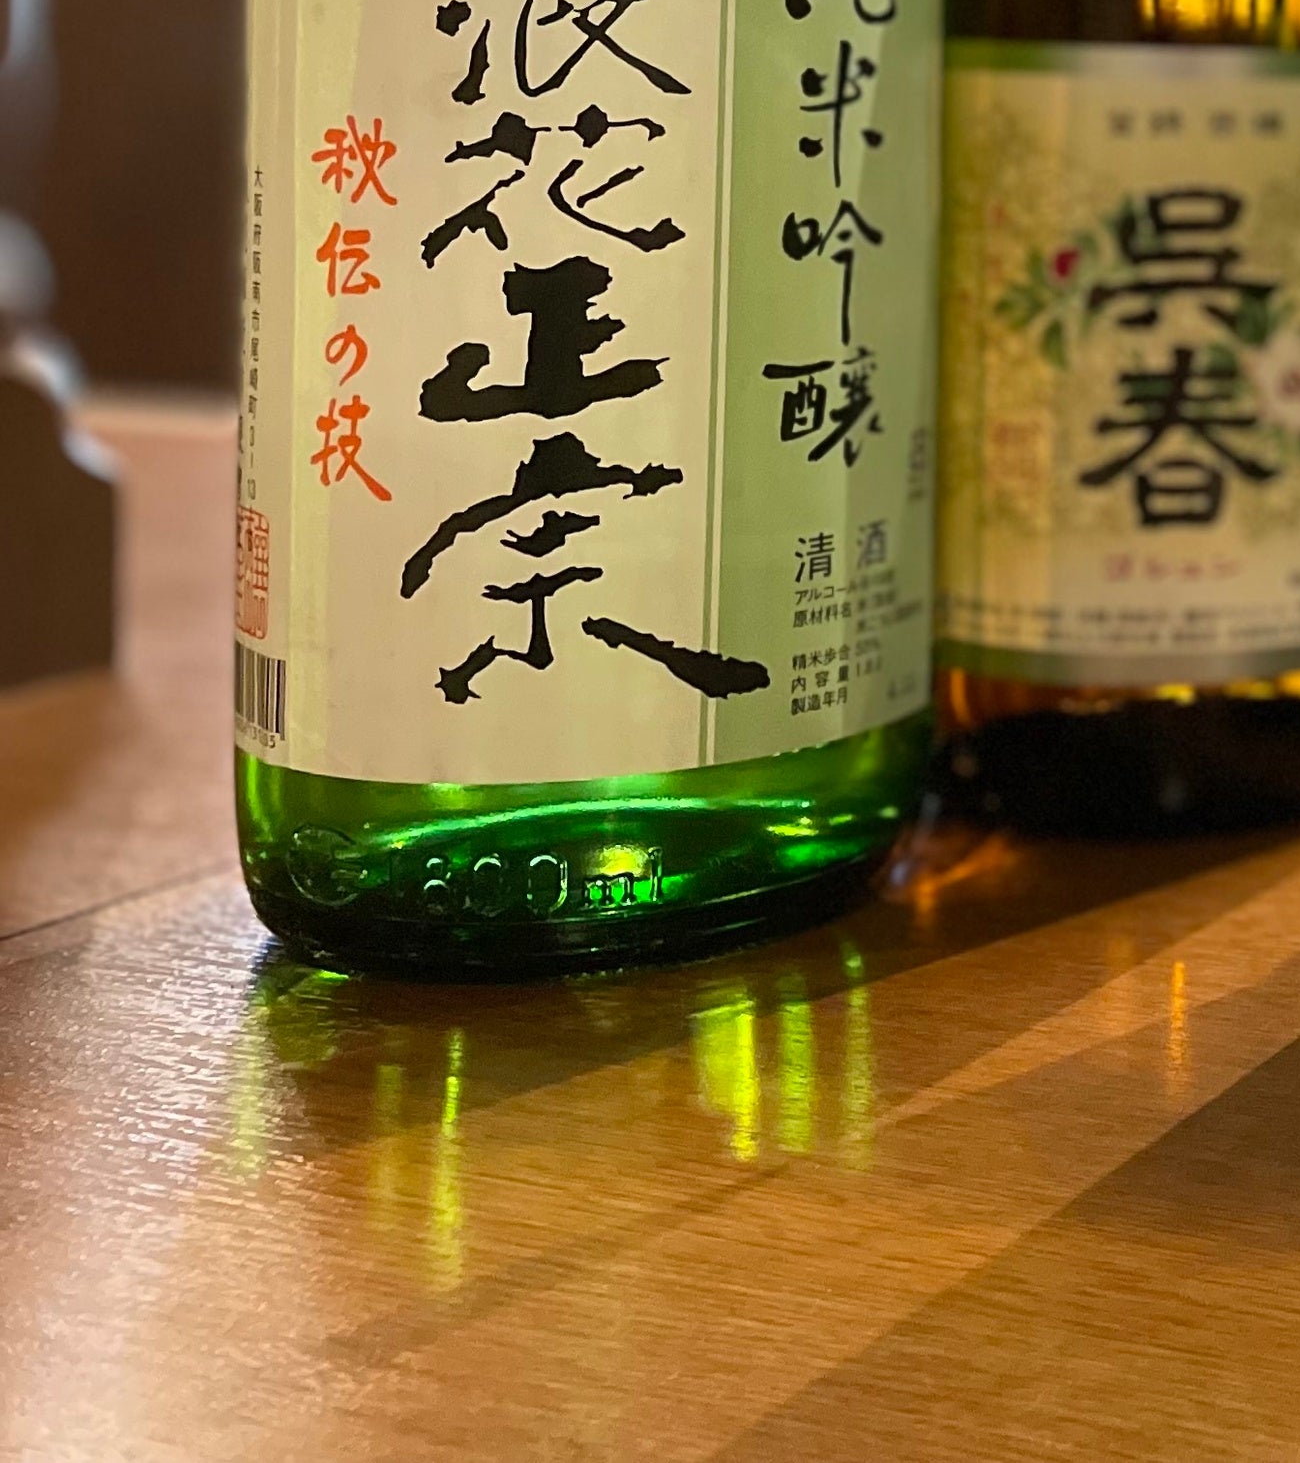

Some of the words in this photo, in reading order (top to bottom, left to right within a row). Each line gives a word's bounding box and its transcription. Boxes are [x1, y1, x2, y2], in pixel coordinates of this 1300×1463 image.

[311, 114, 399, 501] 秘伝の技
[1079, 190, 1279, 528] 呉春
